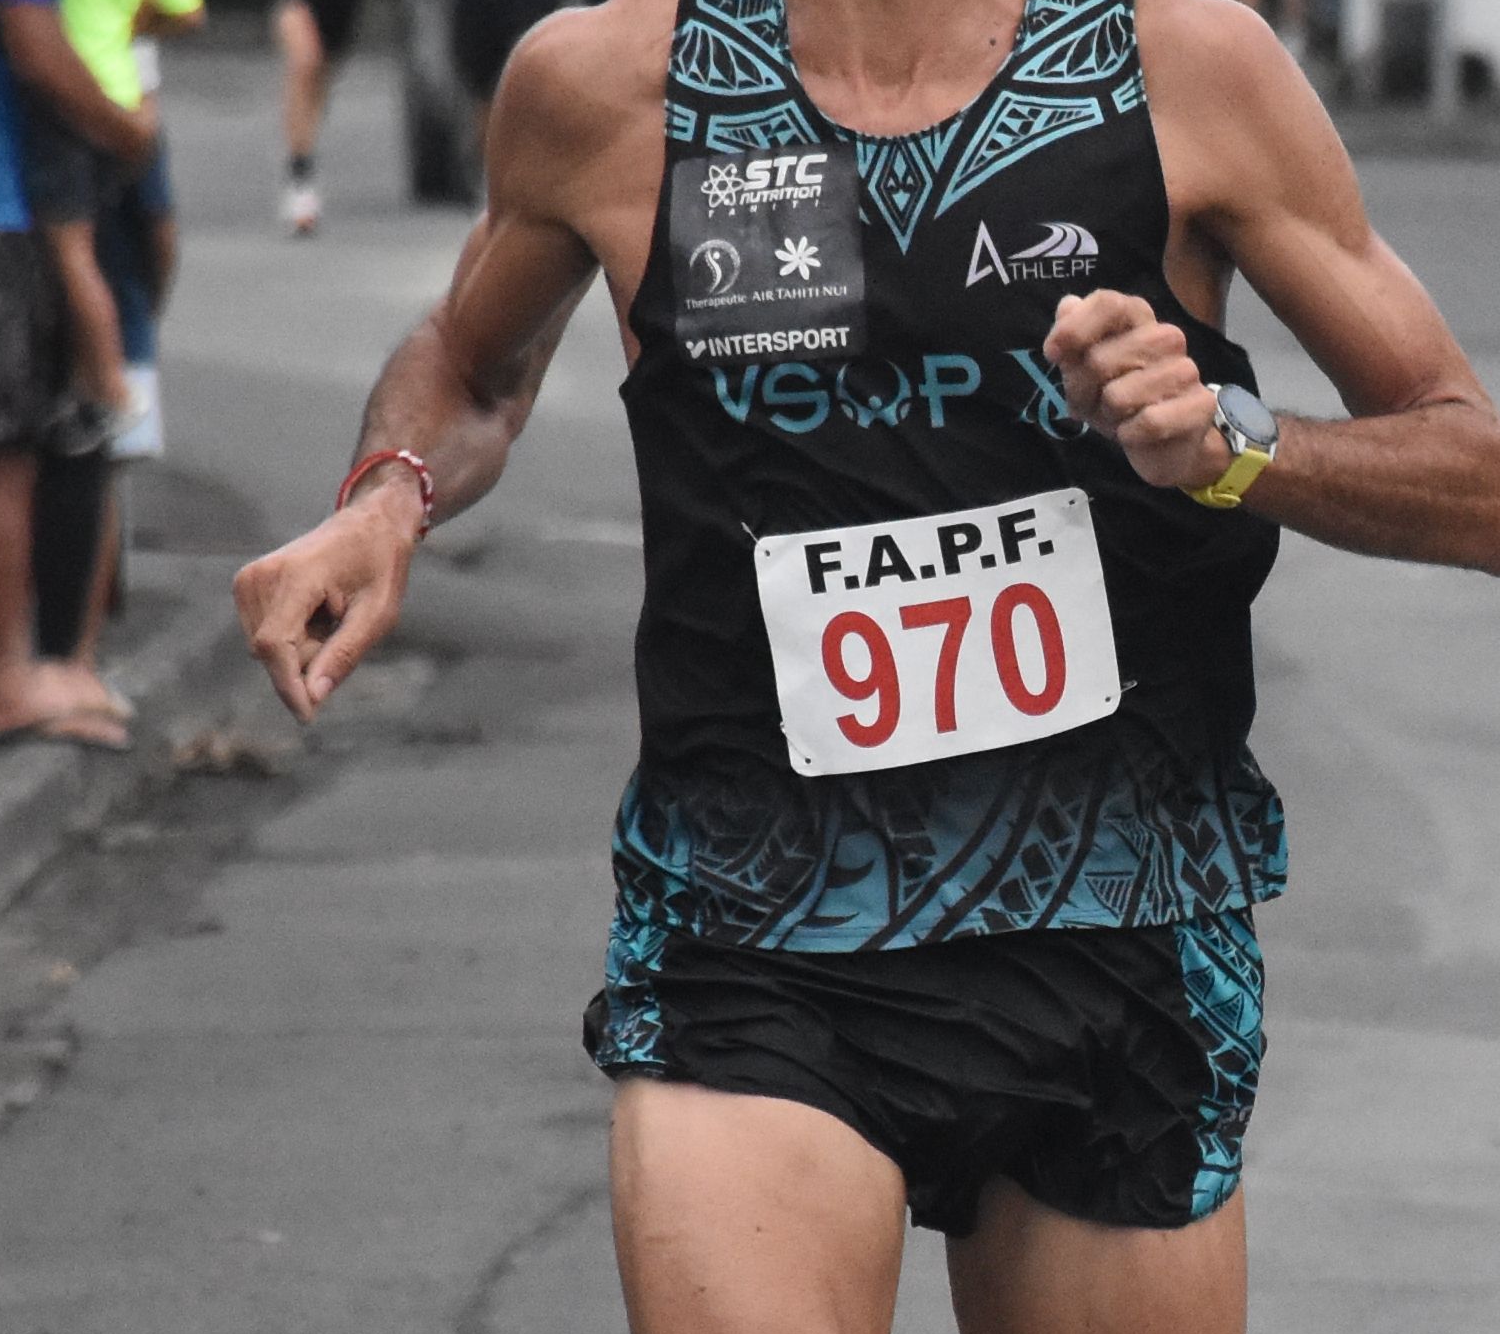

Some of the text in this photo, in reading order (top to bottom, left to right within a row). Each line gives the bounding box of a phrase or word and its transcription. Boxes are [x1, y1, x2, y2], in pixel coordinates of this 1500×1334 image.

[743, 153, 829, 191] STC
[685, 294, 747, 310] Therapeutic
[752, 285, 848, 302] AIR TAHITI NUI
[708, 327, 850, 357] INTERSPORT
[803, 508, 1055, 595] F.A.P.F.
[821, 582, 1067, 749] 970
